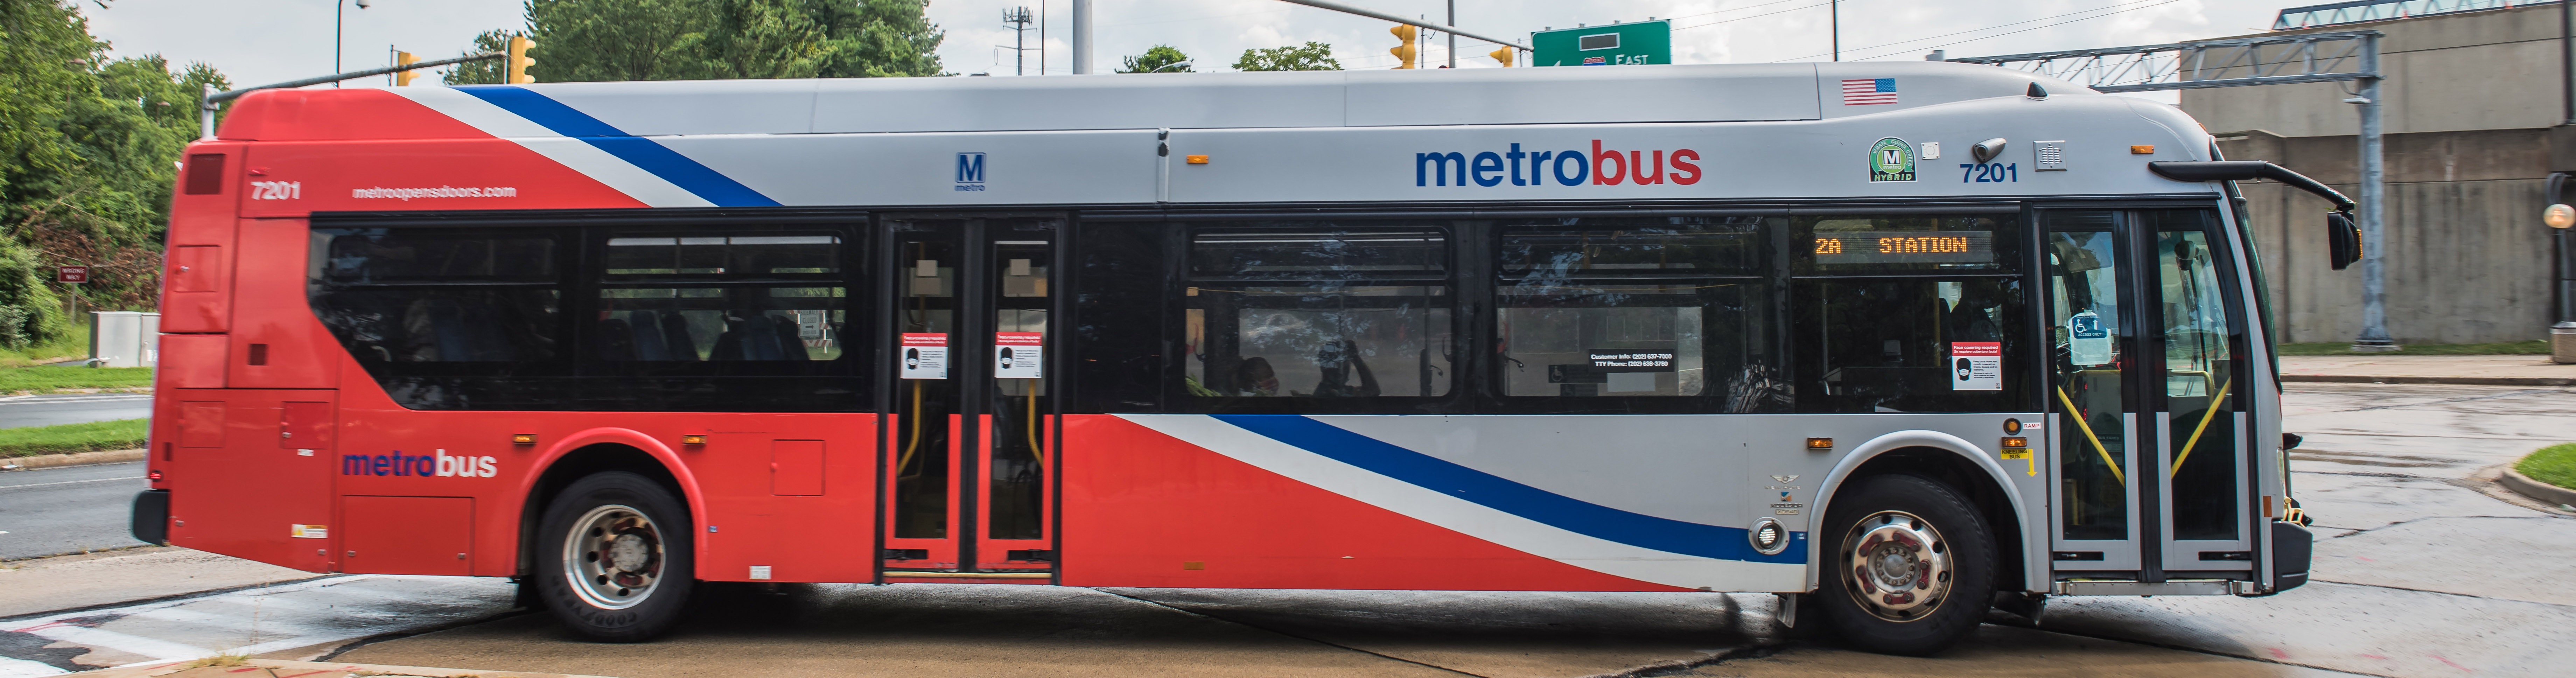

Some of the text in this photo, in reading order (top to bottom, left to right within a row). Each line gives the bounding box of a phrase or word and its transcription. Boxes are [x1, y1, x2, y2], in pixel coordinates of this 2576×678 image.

[1615, 54, 1649, 65] EAST
[1872, 140, 1887, 153] WMATA
[1891, 140, 1906, 149] GOING
[1416, 139, 1702, 187] metrobus
[1883, 150, 1900, 164] M
[958, 154, 983, 181] M
[1960, 163, 2017, 183] 7201
[250, 181, 301, 200] 7201
[352, 185, 517, 201] metroopensdoors.com
[1816, 237, 1967, 253] 2A STATION
[342, 448, 498, 478] metrobus
